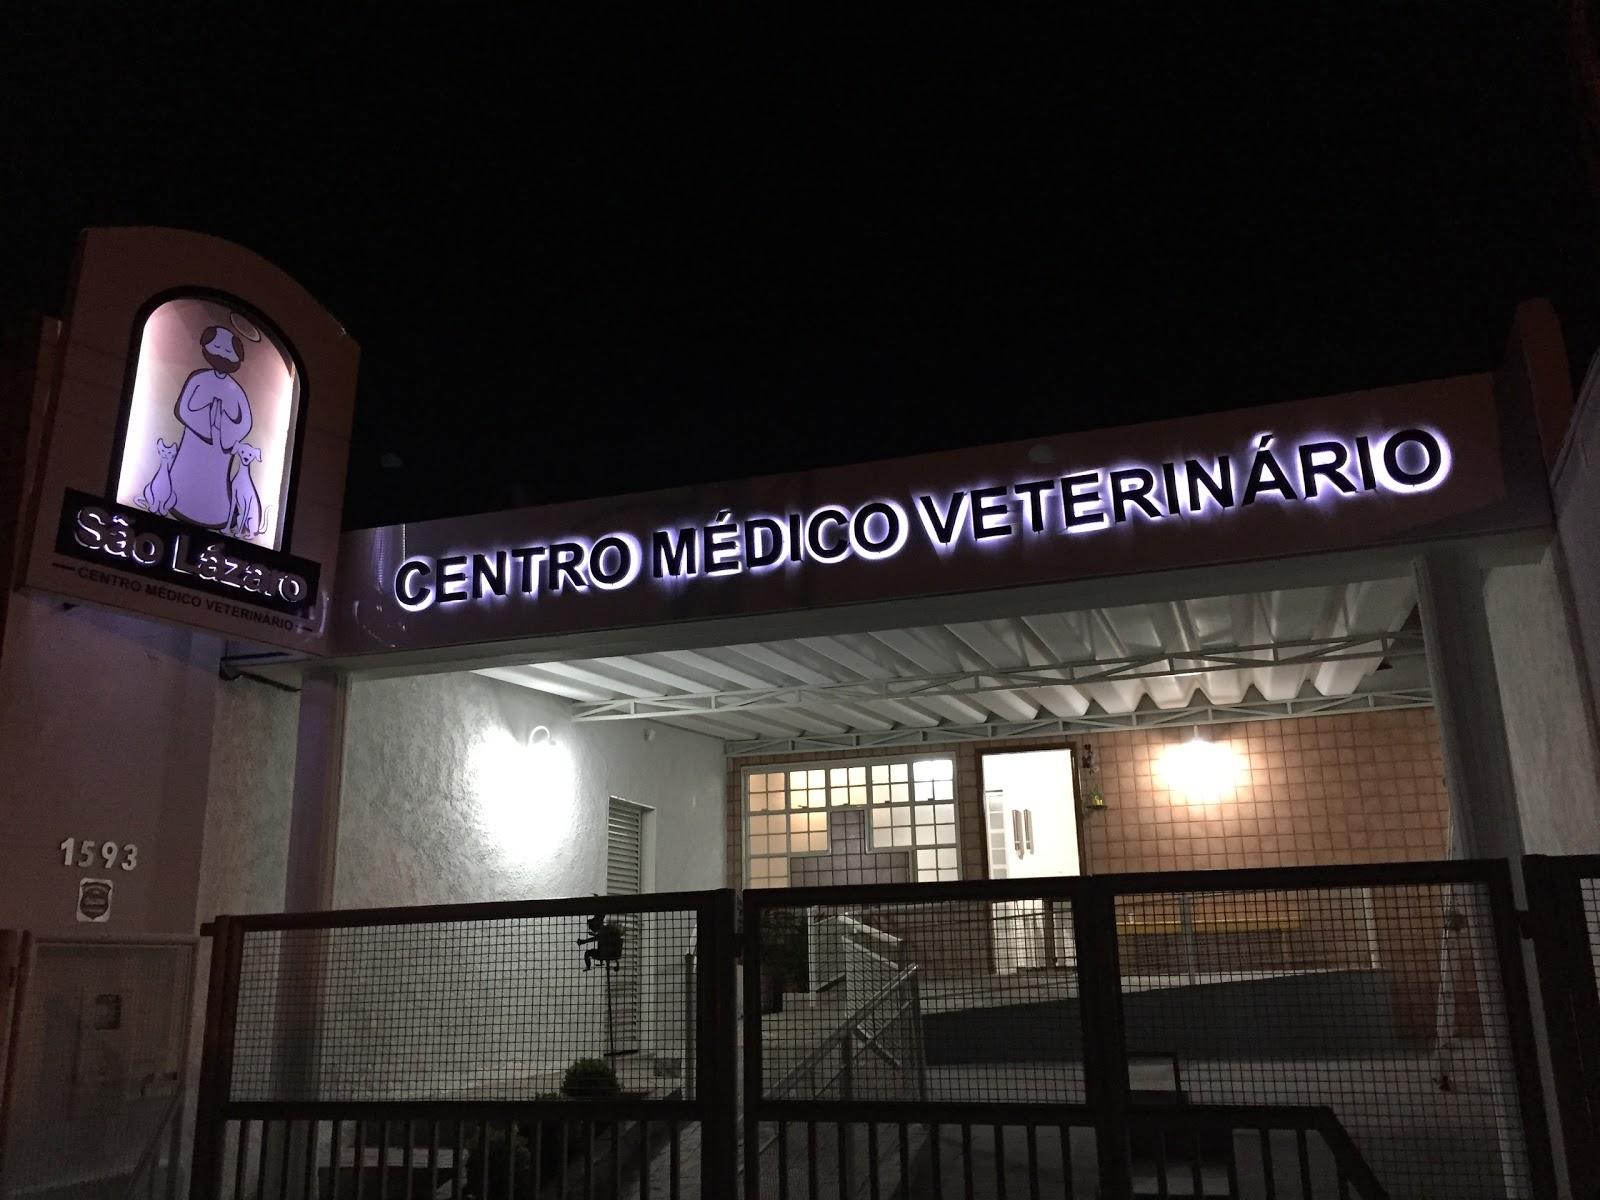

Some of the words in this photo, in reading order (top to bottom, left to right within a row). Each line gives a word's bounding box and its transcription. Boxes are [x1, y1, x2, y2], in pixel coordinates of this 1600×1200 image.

[74, 506, 164, 564] São
[394, 536, 630, 607] CENTRO
[653, 502, 900, 577] MÉDICO
[919, 428, 1442, 544] VETERINÁRIO
[78, 567, 142, 592] CENTRO
[145, 582, 201, 607] MÉDICO
[206, 599, 293, 631] VETERINÁRIO
[60, 837, 138, 871] 1593
